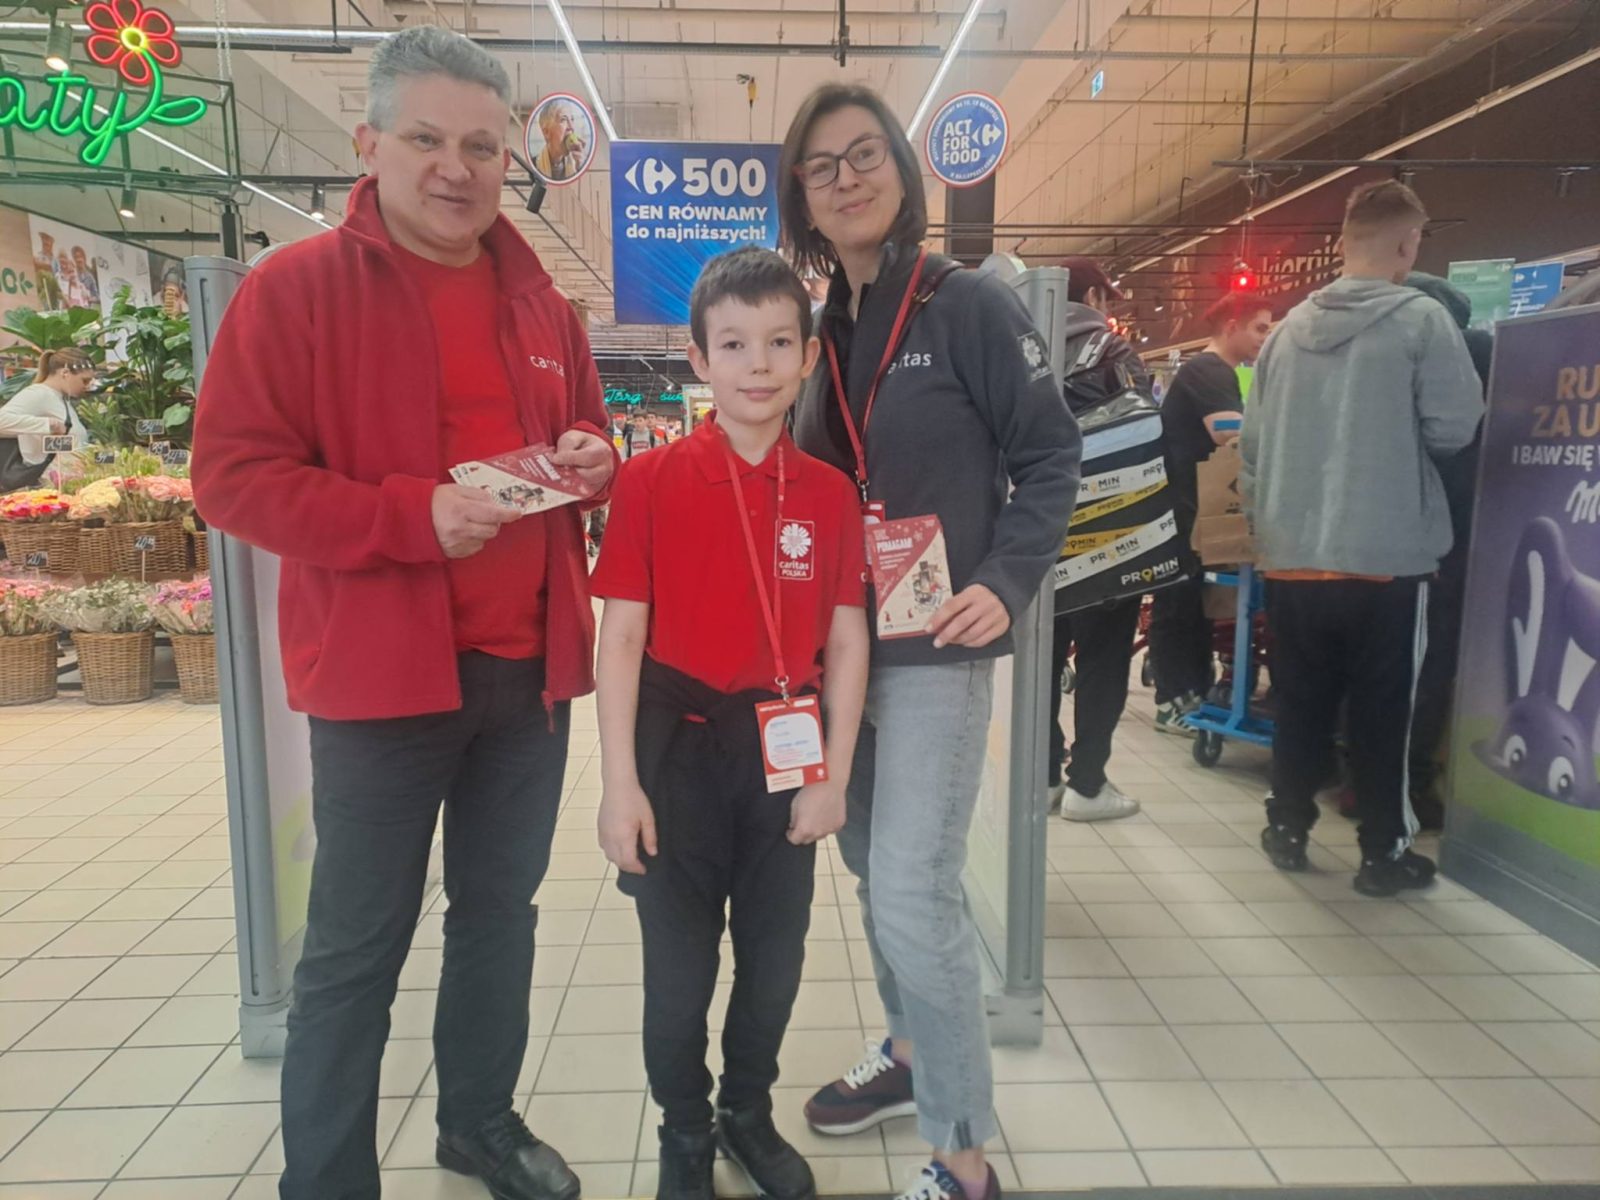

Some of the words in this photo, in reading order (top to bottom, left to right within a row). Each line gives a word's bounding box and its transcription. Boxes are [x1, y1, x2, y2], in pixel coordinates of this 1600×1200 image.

[943, 119, 973, 138] ACT
[942, 135, 970, 152] FOR
[942, 148, 981, 166] FOOD
[682, 157, 767, 197] 500
[625, 205, 663, 220] CEN
[668, 202, 768, 222] RÓWNAMY
[626, 223, 650, 239] do
[655, 223, 767, 243] najniższych!
[1556, 364, 1600, 401] RU
[1531, 403, 1572, 438] ZA
[1520, 445, 1562, 466] BAW
[1563, 444, 1595, 472] SIĘ
[1565, 480, 1600, 524] M
[778, 560, 810, 571] caritas
[781, 569, 808, 578] POLSKA
[1121, 557, 1179, 585] PROMIN
